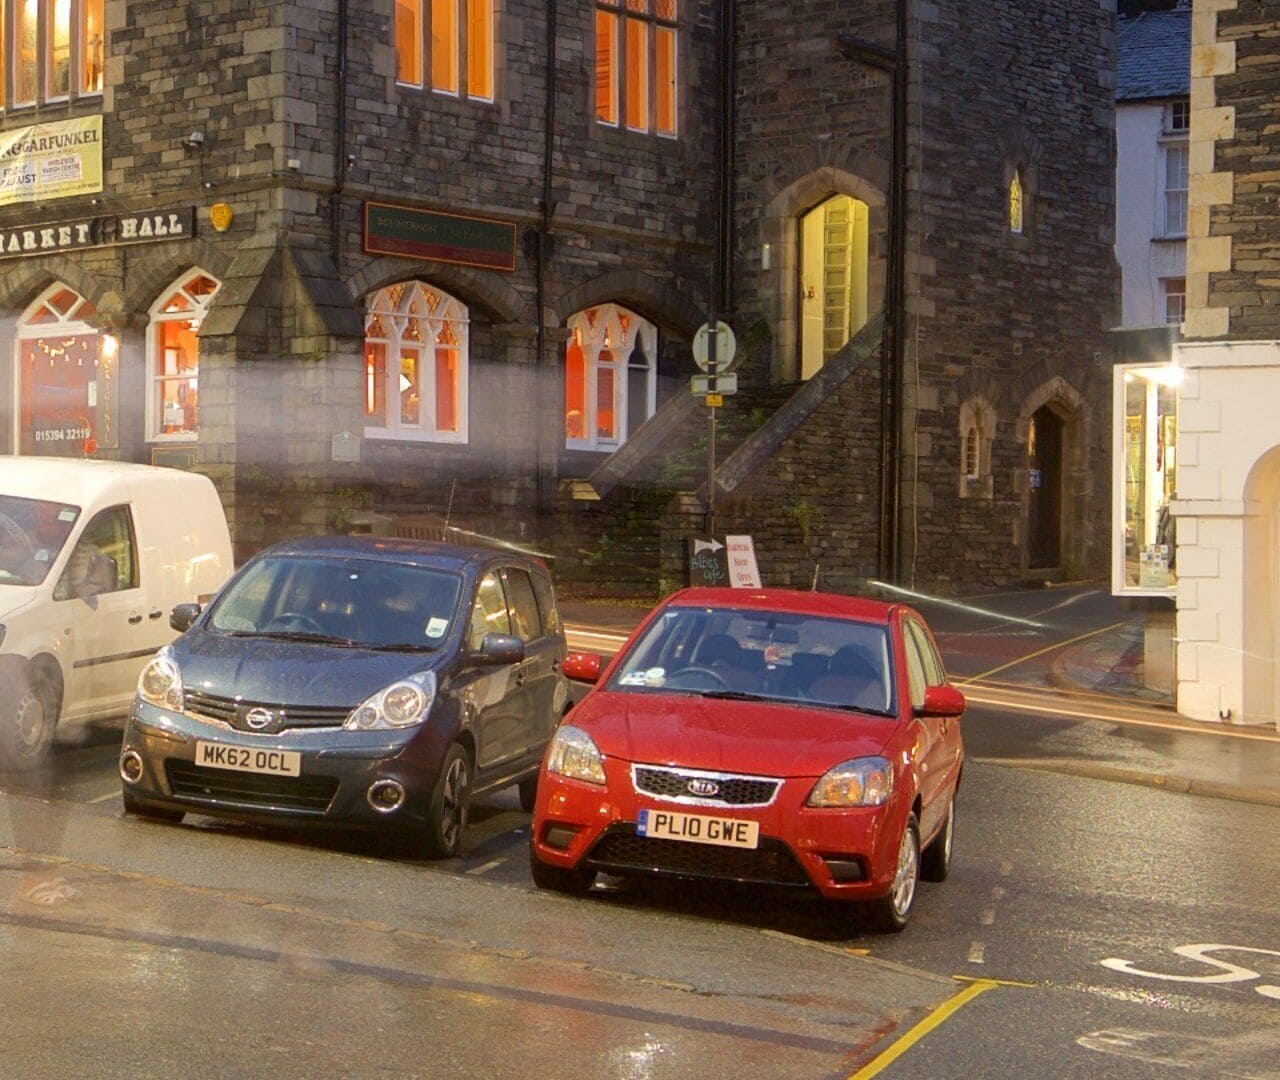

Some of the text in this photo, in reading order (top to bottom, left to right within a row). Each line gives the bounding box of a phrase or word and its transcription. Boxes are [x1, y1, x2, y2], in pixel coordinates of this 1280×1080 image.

[22, 129, 100, 153] GARFUNKEL
[121, 214, 182, 238] HALL
[35, 428, 90, 441] 015394 32119
[203, 745, 290, 771] MK62 OCL
[693, 781, 713, 793] KIA
[654, 814, 749, 842] PL10 GWE
